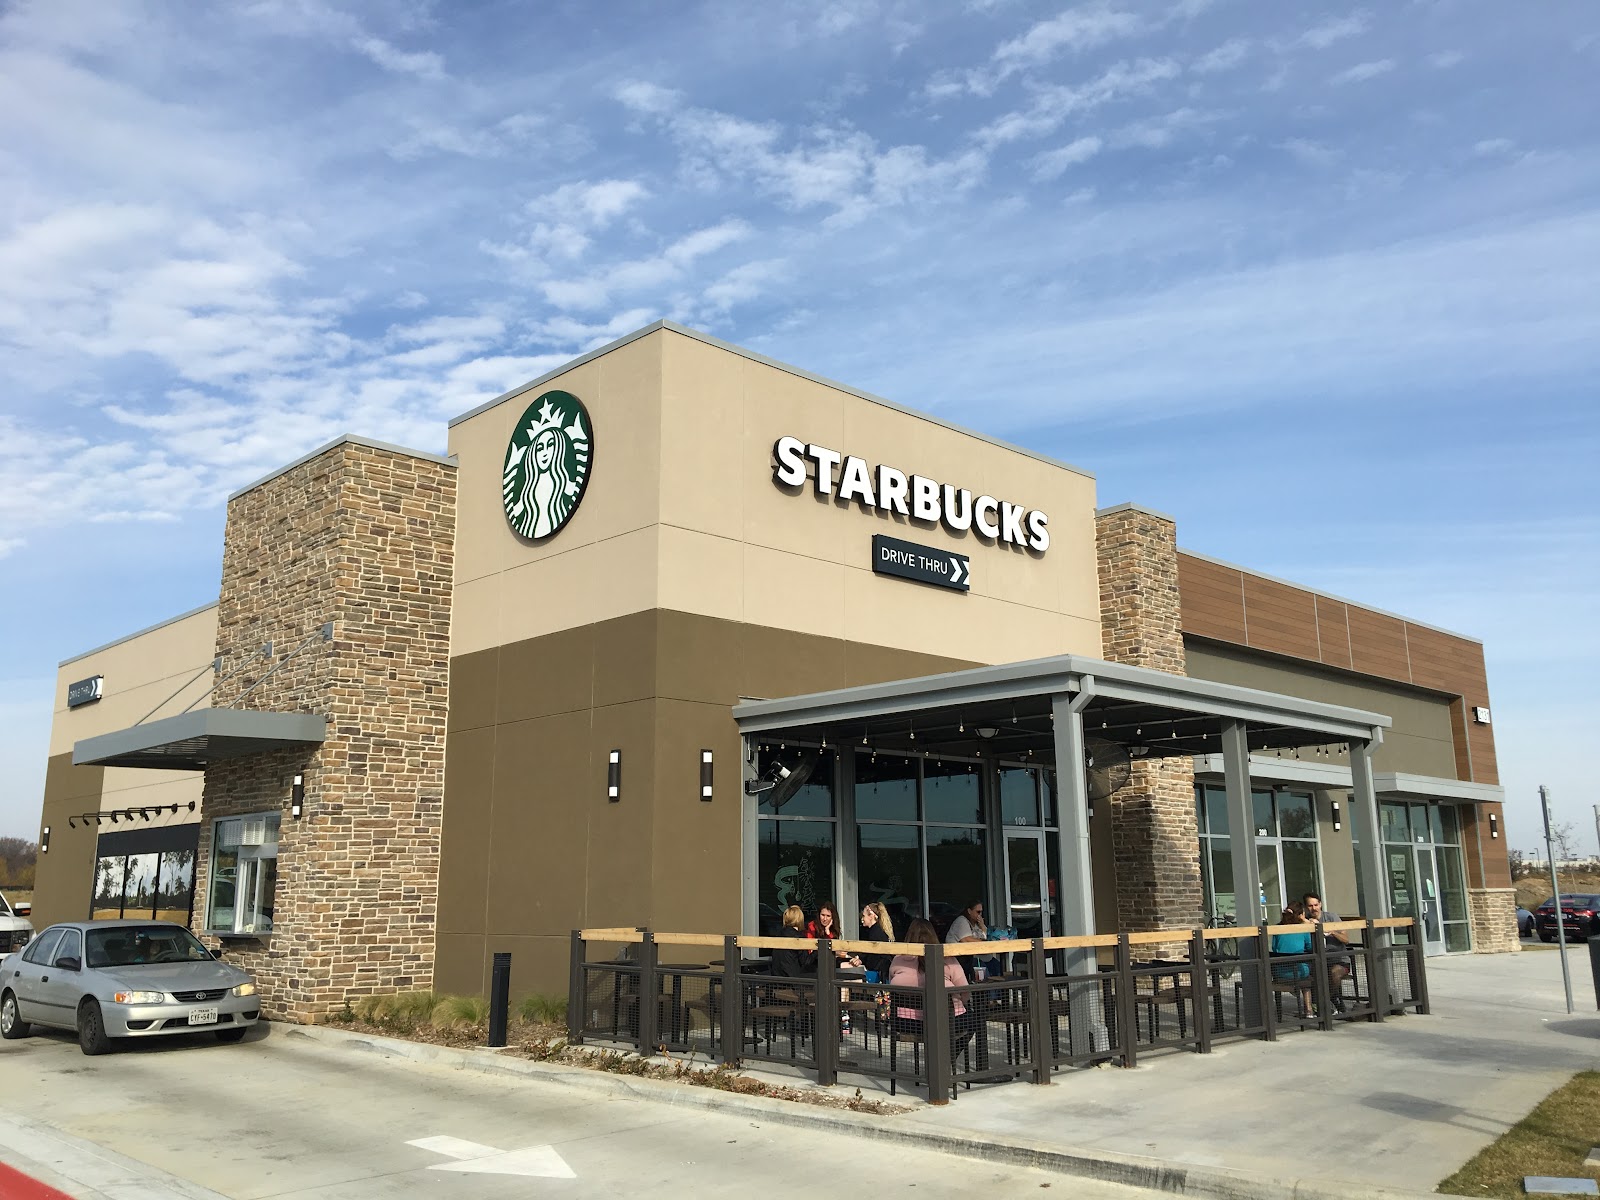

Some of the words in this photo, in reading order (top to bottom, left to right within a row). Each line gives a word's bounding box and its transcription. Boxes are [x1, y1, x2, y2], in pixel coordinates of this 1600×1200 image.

[774, 436, 1050, 552] STARBUCKS
[881, 547, 915, 567] DRIVE
[918, 556, 948, 574] THRU
[1015, 816, 1026, 825] 100
[1258, 828, 1267, 836] 200
